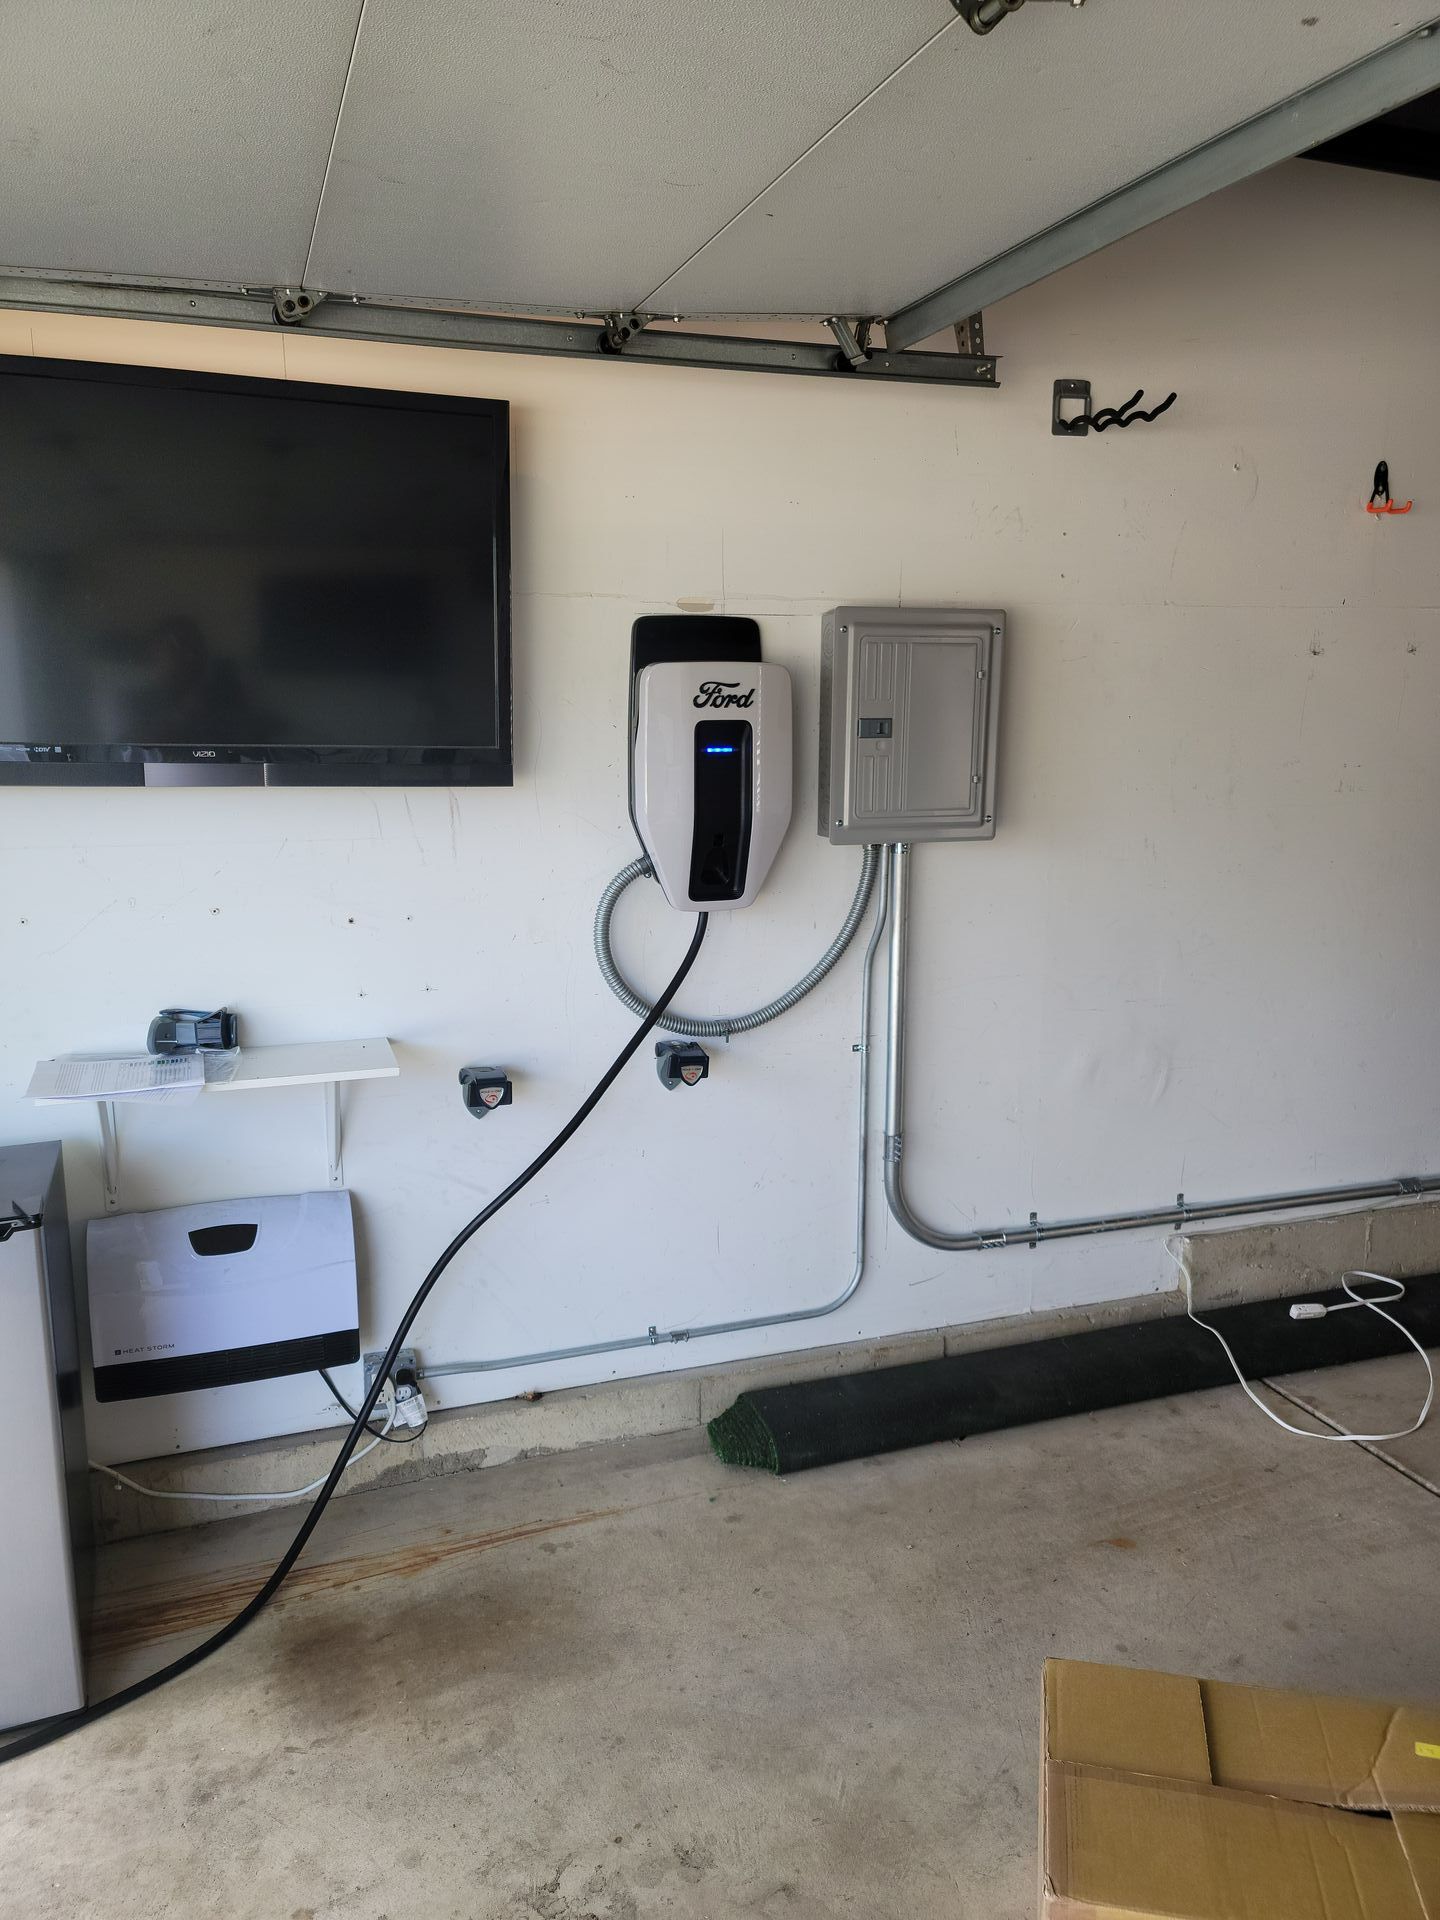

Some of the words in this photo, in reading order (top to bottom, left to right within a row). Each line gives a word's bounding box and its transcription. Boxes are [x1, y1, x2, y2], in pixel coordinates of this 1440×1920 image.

[693, 681, 755, 708] Ford
[192, 750, 216, 758] VIZIO
[123, 1347, 145, 1355] HEAT
[147, 1343, 175, 1352] STORM
